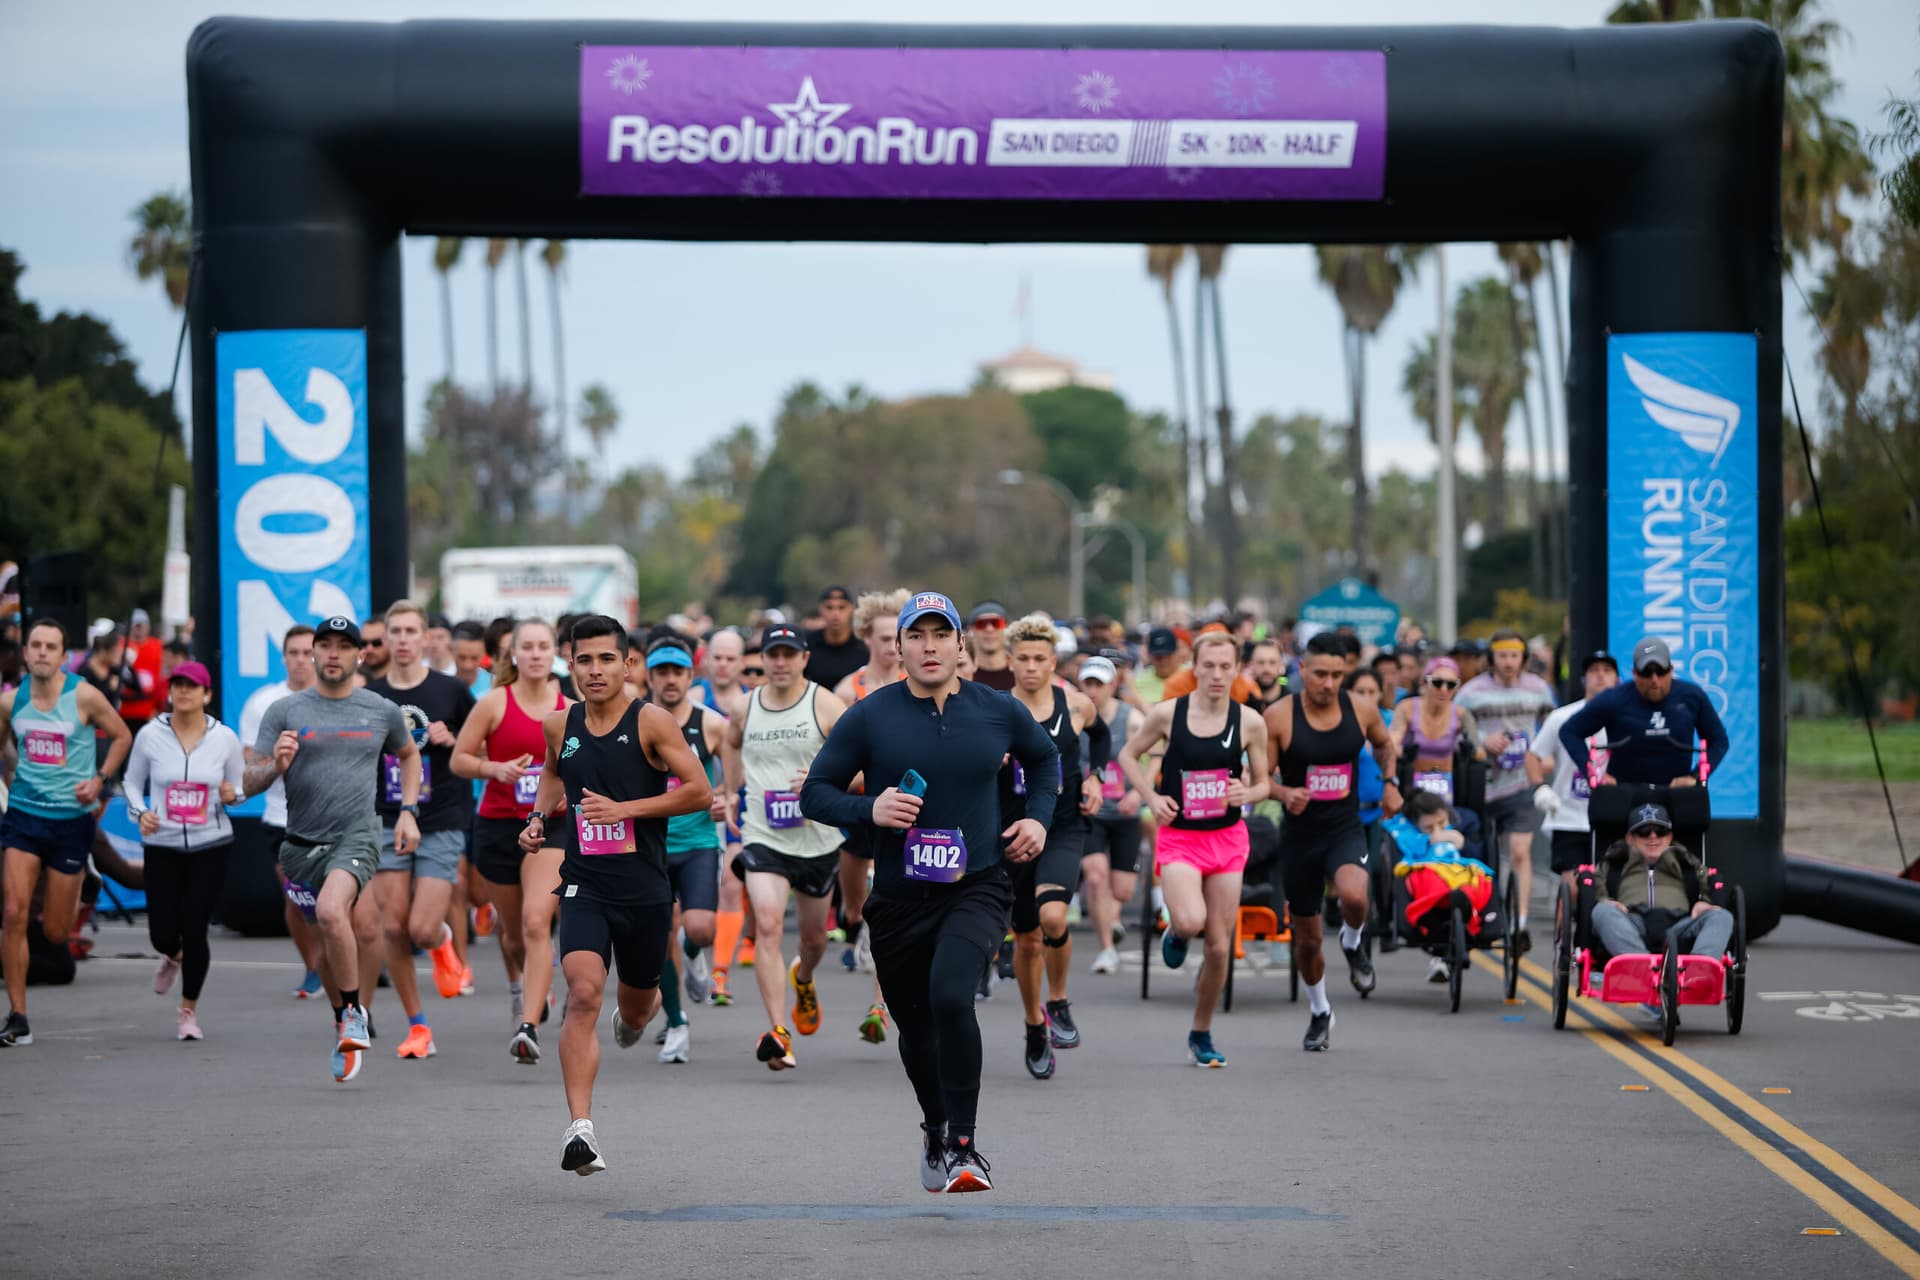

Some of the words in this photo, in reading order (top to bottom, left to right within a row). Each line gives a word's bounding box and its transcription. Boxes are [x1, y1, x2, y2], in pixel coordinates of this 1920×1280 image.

[607, 114, 980, 165] ResolutionRun
[1002, 131, 1046, 155] SAN
[1051, 132, 1120, 155] DIEGO
[1179, 132, 1210, 155] 5K
[1225, 132, 1268, 156] 10K
[1283, 133, 1343, 156] HALF
[1689, 478, 1728, 569] SAN
[1642, 478, 1684, 678] RUNNI
[748, 729, 809, 742] MILESTONE
[1187, 781, 1226, 800] 3352
[582, 820, 626, 842] 3113
[910, 844, 961, 869] 1402
